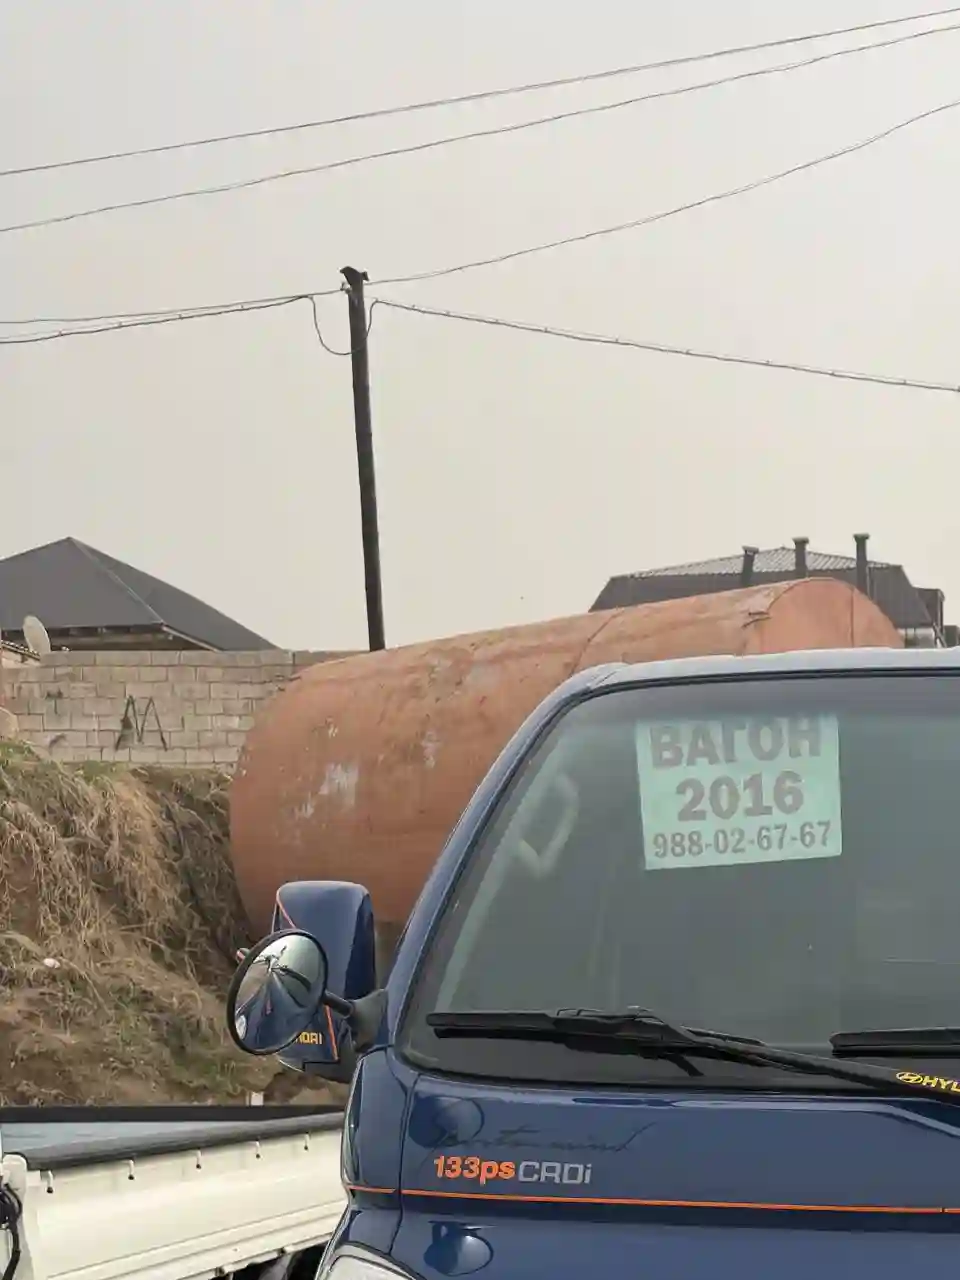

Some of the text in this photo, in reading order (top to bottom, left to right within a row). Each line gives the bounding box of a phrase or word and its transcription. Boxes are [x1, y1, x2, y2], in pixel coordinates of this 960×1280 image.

[651, 717, 821, 768] ВАГОН
[675, 769, 804, 822] 2016
[652, 820, 831, 858] 988-02-67-67
